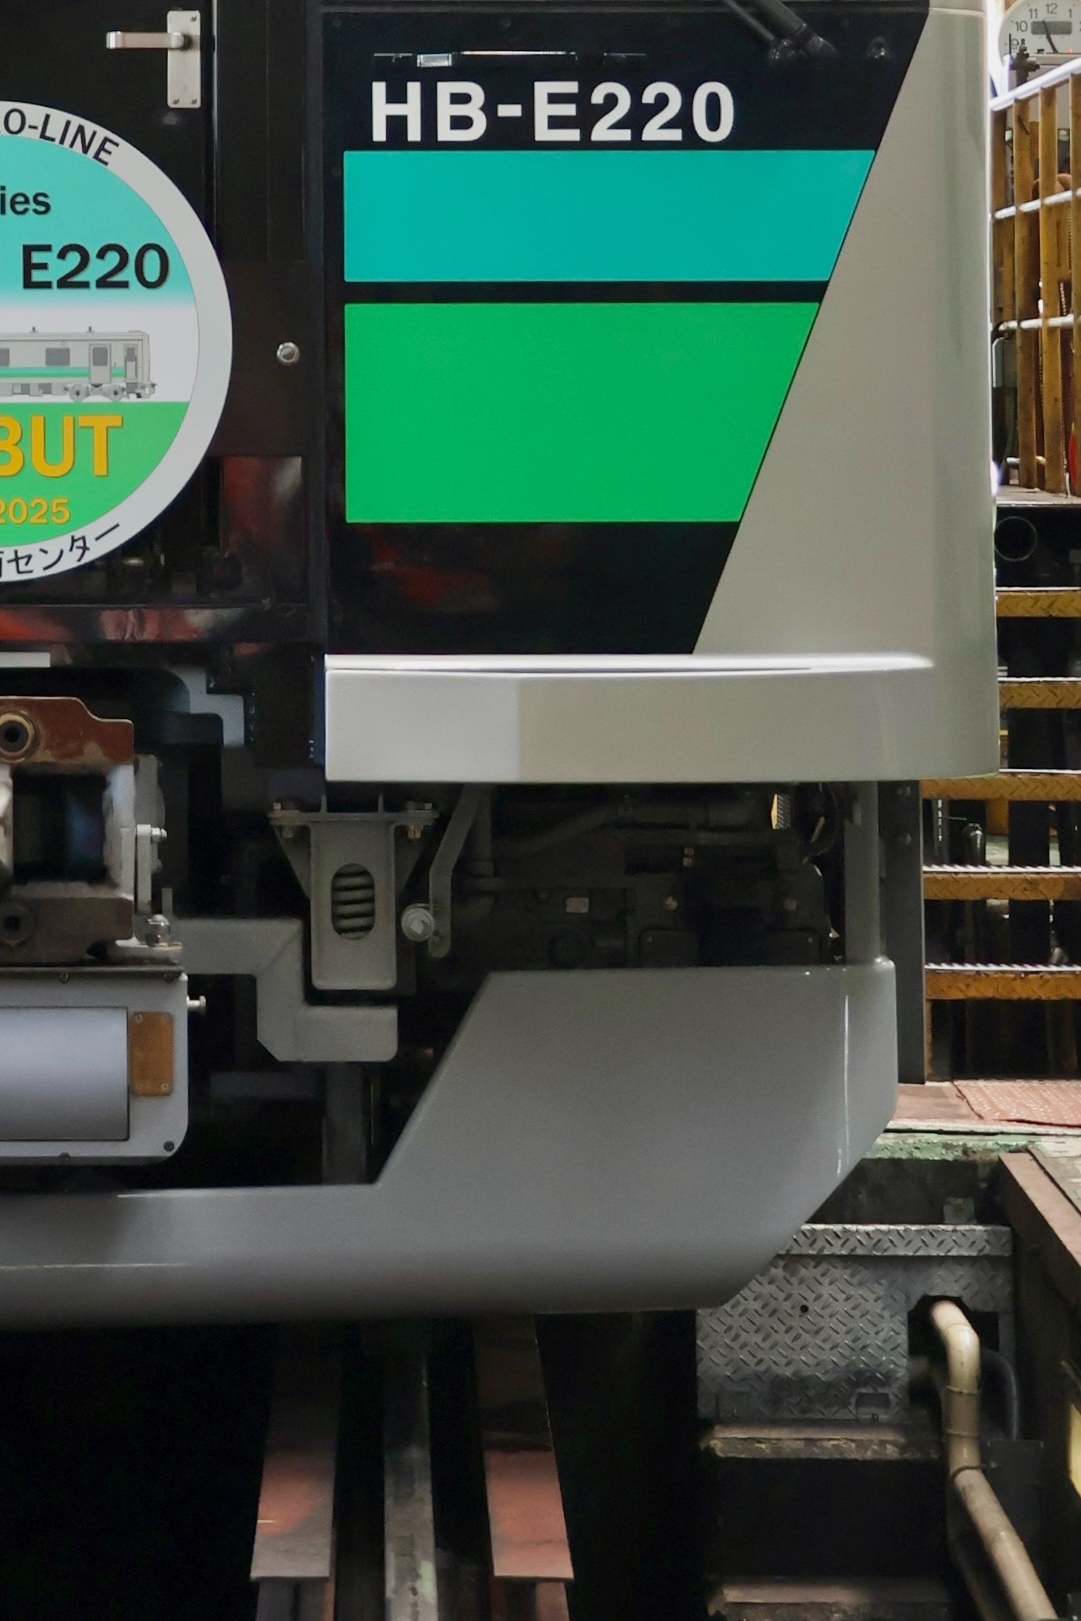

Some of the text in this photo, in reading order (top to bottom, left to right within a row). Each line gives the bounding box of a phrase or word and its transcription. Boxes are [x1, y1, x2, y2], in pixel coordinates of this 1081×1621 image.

[1028, 8, 1038, 19] 11
[1045, 2, 1058, 15] 12
[1015, 20, 1028, 32] 10
[372, 81, 734, 142] HB-E220
[22, 242, 170, 290] E220
